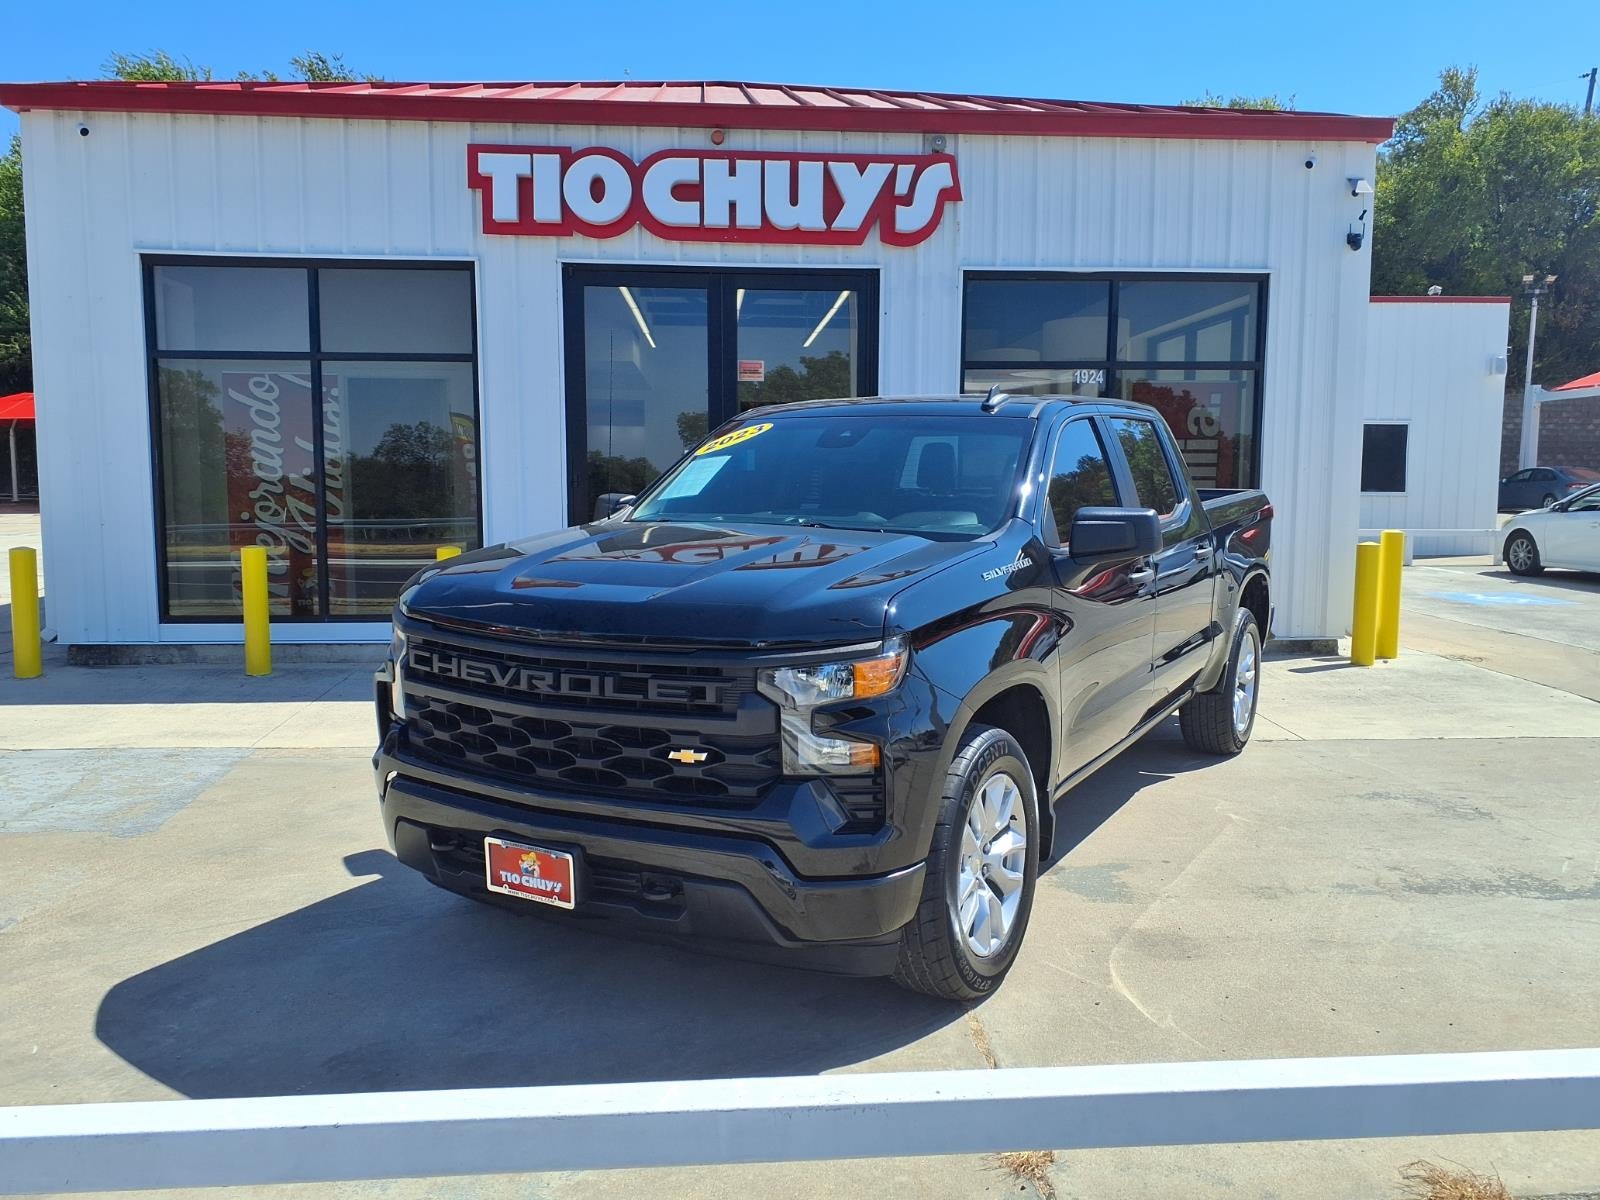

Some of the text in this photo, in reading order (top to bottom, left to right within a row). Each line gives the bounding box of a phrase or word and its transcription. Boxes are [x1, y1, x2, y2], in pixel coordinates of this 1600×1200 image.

[477, 152, 954, 233] TIO CHUY'S
[1074, 369, 1104, 384] 1924
[702, 424, 765, 453] 2023
[982, 556, 1033, 581] SILVERADO
[408, 651, 737, 703] CHEVROLET
[500, 870, 563, 892] TIO CHUY'S
